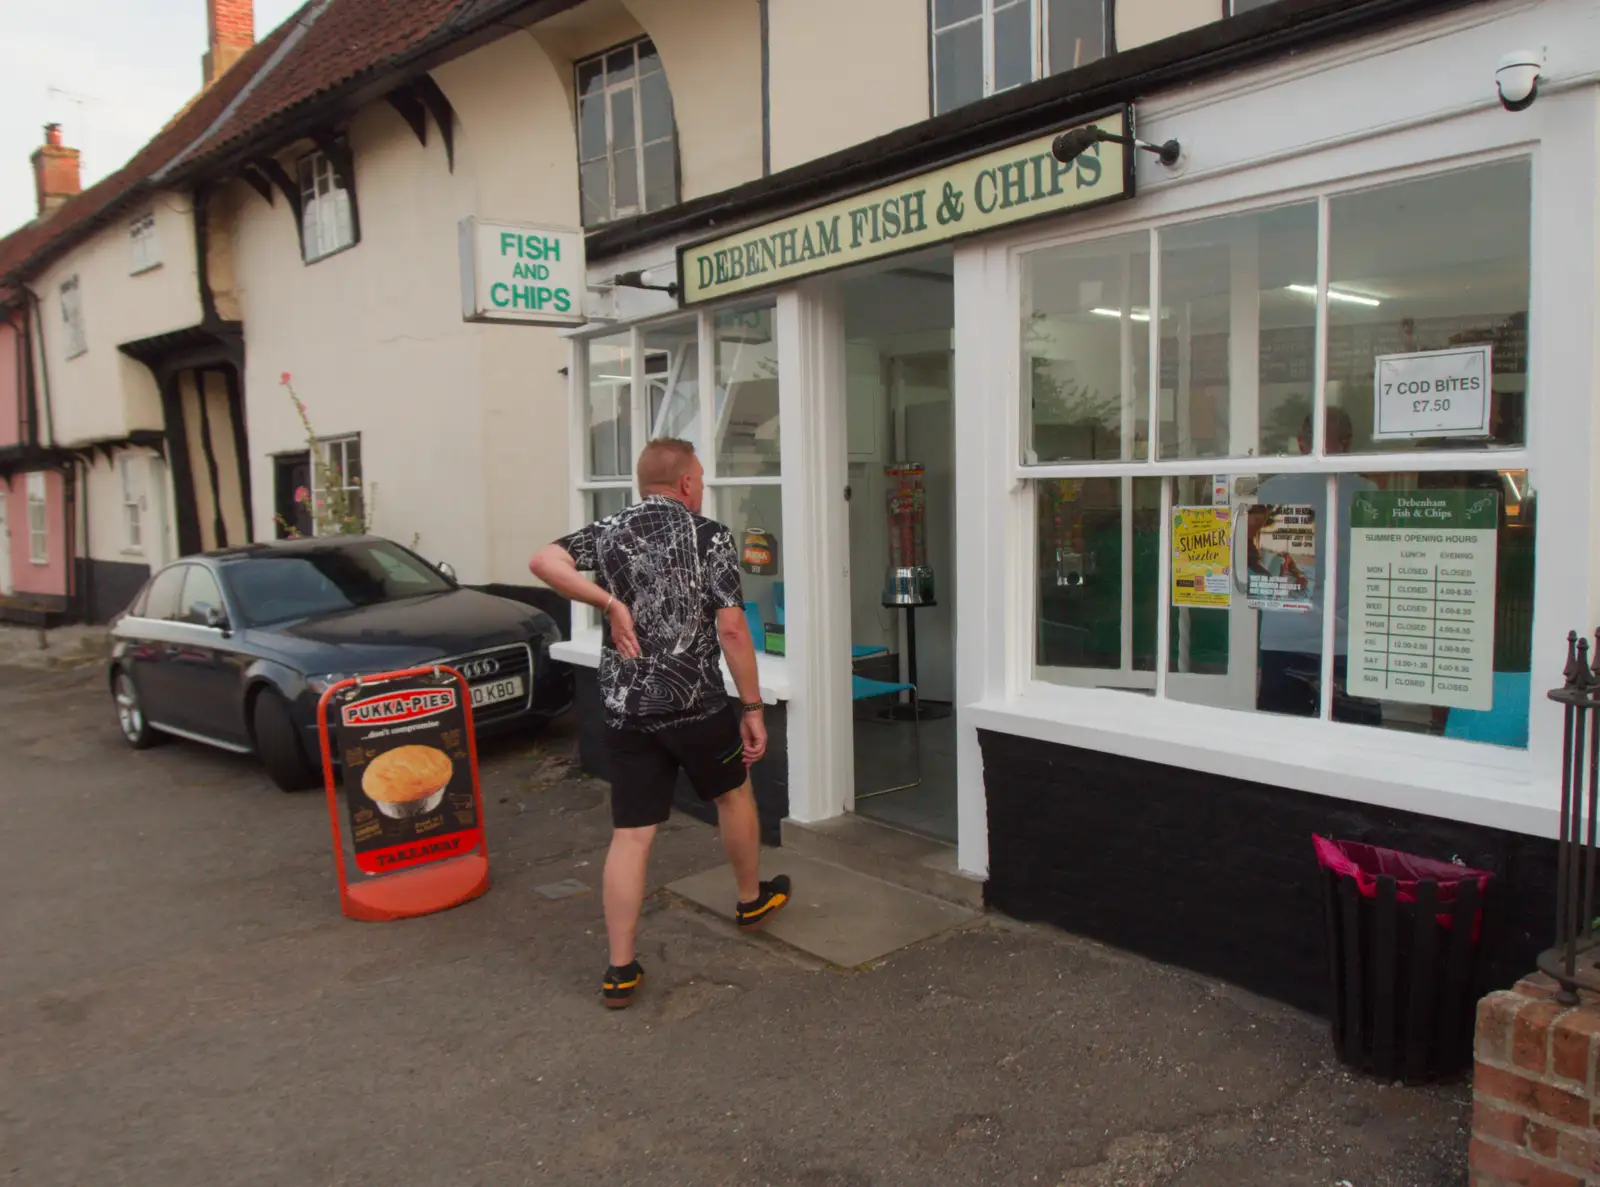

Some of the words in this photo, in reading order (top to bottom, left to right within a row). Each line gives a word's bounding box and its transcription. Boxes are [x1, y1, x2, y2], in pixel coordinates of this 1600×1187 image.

[698, 216, 841, 290] DEBENHAM
[849, 190, 927, 249] FISH
[936, 181, 965, 225] &
[974, 143, 1102, 214] CHIPS
[500, 232, 560, 261] FISH
[512, 262, 549, 280] AND
[490, 281, 571, 312] CHIPS
[1384, 383, 1393, 395] 7
[1397, 380, 1430, 395] COD
[1435, 377, 1480, 392] BITES
[1413, 398, 1451, 413] £7.50
[1397, 498, 1447, 507] Debenham
[1392, 508, 1411, 518] Fish
[1413, 508, 1422, 518] &
[1425, 508, 1453, 521] Chips
[1180, 529, 1226, 553] SUMMER
[1365, 534, 1401, 542] SUMMER
[1404, 534, 1443, 543] OPENING
[1445, 535, 1478, 544] HOURS
[1400, 551, 1426, 559] LUNCH
[1440, 552, 1474, 560] EVENING
[1366, 566, 1383, 574] MON
[1398, 567, 1428, 576] CLOSED
[1440, 569, 1472, 577] CLOSED
[1366, 584, 1380, 592] TUE
[1397, 585, 1428, 594] CLOSED
[1396, 604, 1427, 613] CLOSED
[1396, 623, 1426, 631] CLOSED
[1364, 656, 1378, 664] SAT
[1363, 674, 1378, 682] SUN
[1395, 678, 1426, 688] CLOSED
[1437, 682, 1469, 692] CLOSED
[376, 838, 461, 867] TAKEAWAY
